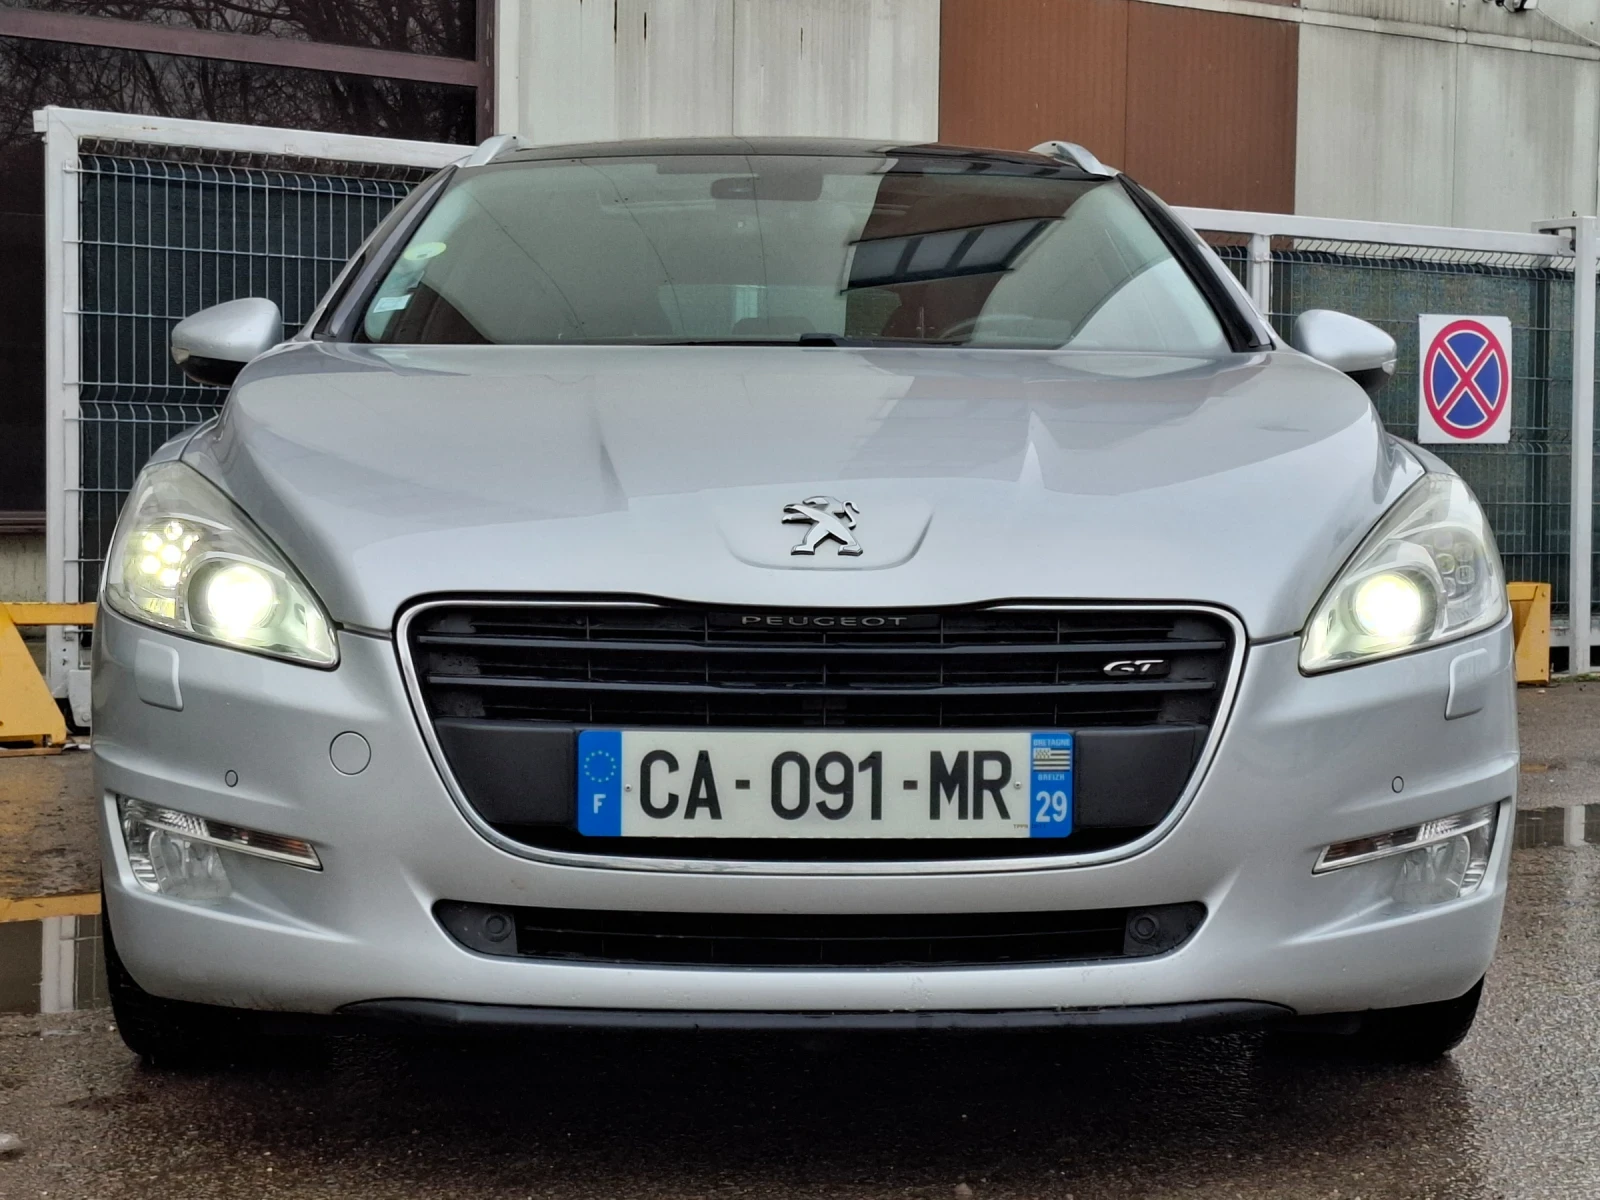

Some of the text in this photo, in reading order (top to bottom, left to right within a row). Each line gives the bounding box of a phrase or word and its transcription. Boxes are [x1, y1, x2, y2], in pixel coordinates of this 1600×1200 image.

[741, 616, 907, 627] PEUGEOT
[1103, 660, 1164, 676] GT
[593, 793, 607, 814] F
[1035, 790, 1068, 823] 29
